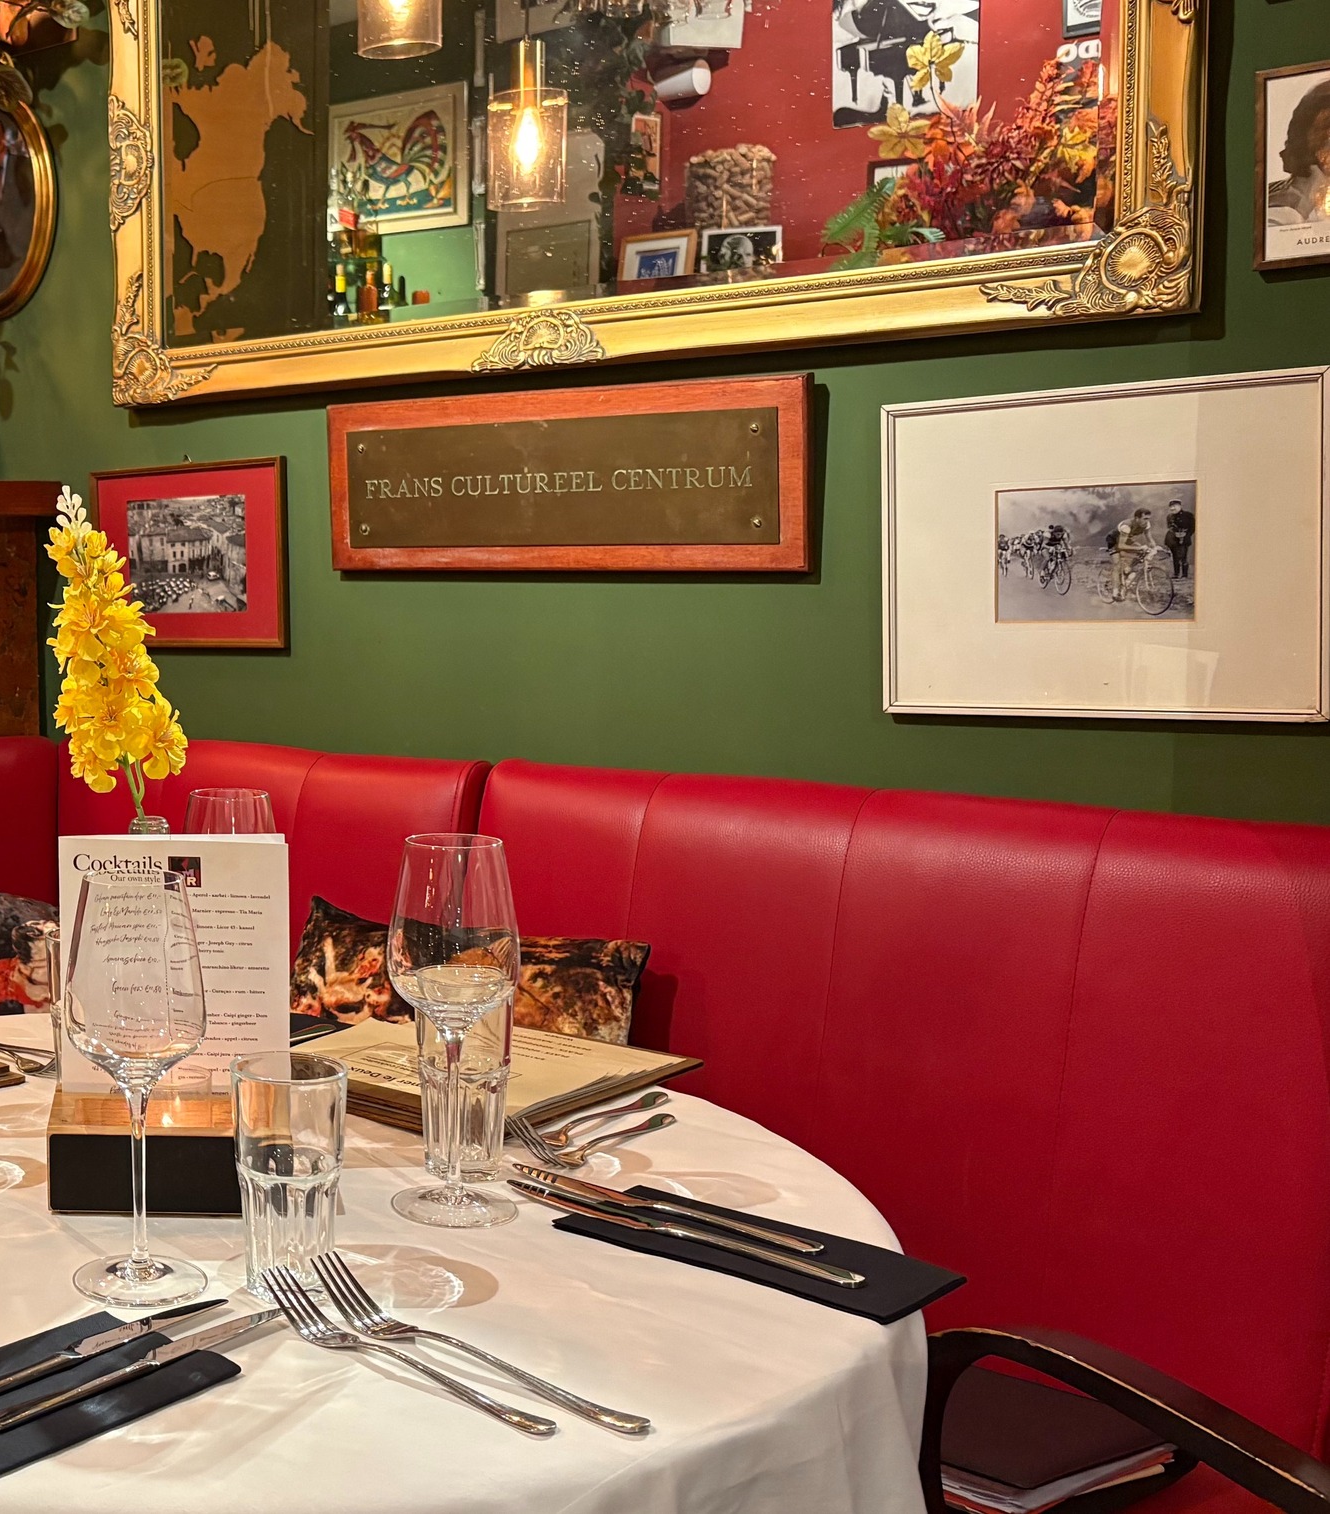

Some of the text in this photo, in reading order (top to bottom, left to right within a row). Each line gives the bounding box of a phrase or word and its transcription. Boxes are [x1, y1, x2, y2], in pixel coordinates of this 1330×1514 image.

[365, 466, 752, 499] FRANS CULTUREEL CENTRUM
[73, 853, 163, 873] Cocktails
[110, 874, 125, 882] Our
[144, 875, 161, 884] style
[348, 1067, 382, 1078] Deux
